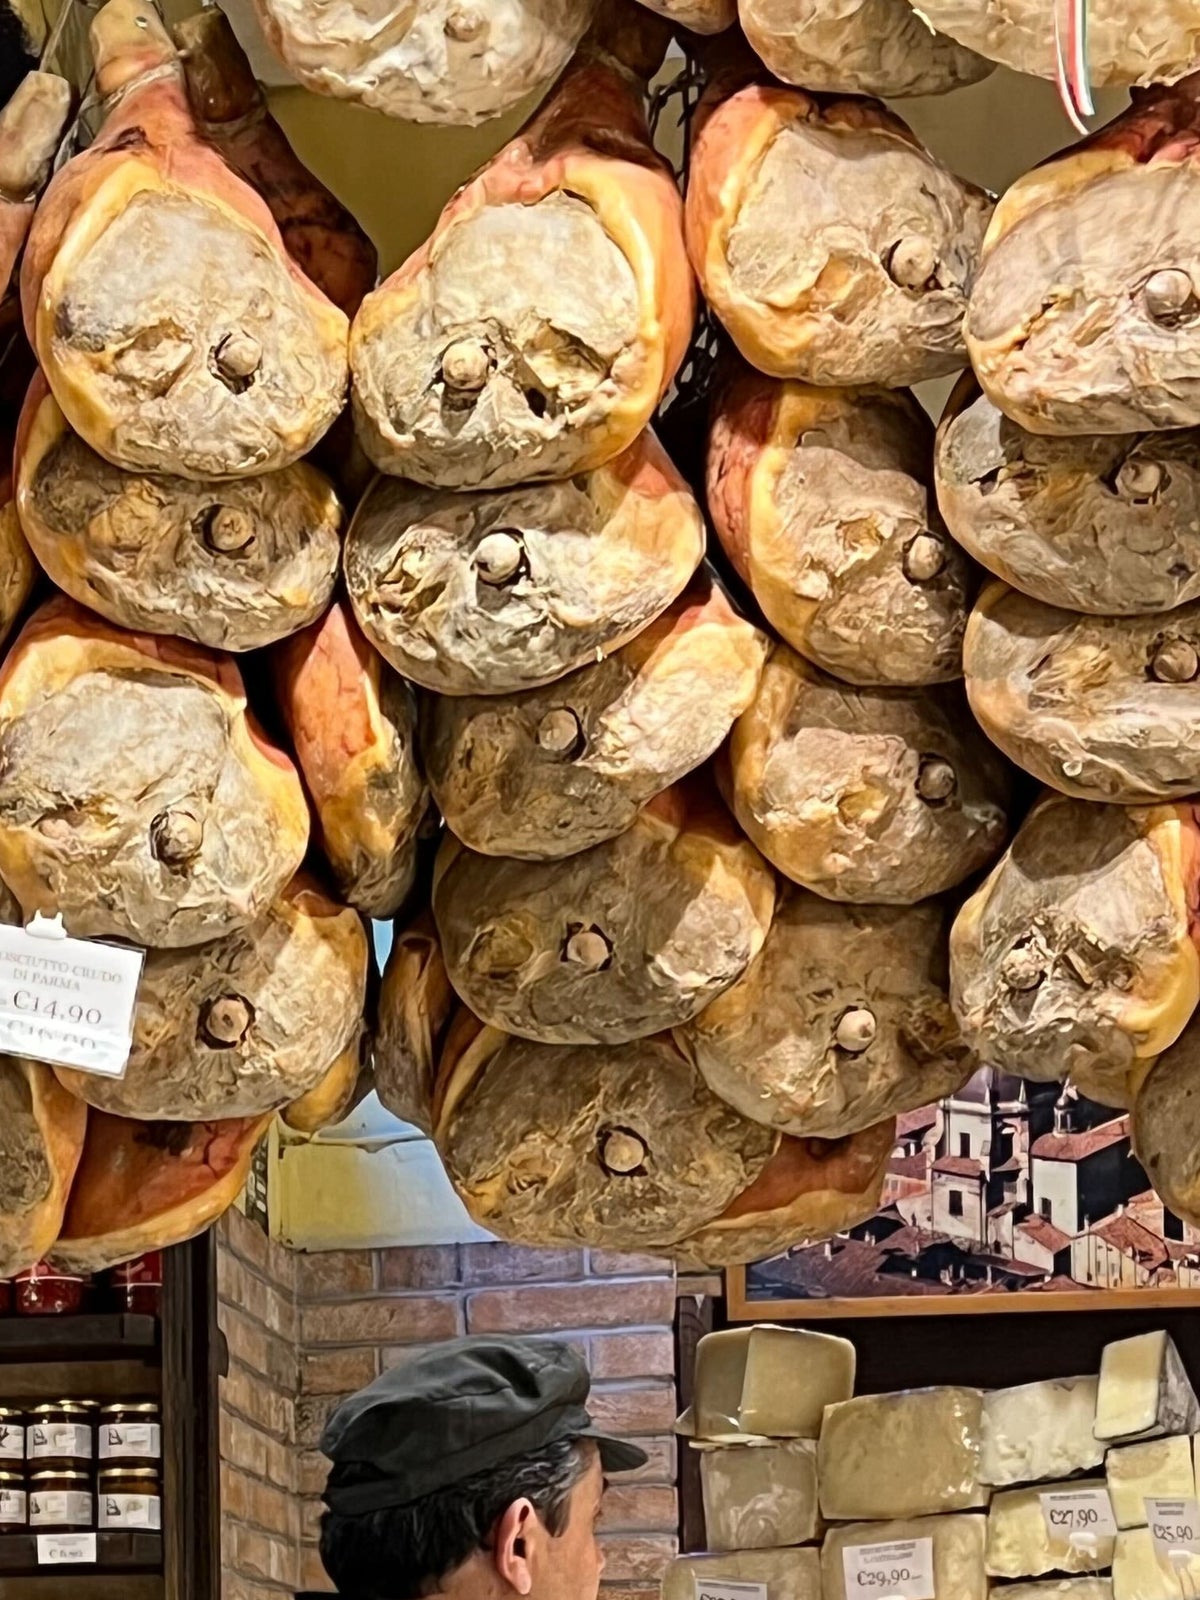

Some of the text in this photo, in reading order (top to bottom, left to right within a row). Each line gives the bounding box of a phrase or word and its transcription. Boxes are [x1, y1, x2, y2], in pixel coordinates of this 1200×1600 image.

[13, 967, 81, 992] DI PARMA
[72, 965, 122, 984] CRUDO
[1050, 1508, 1098, 1528] €27,90
[857, 1568, 910, 1587] €29,90
